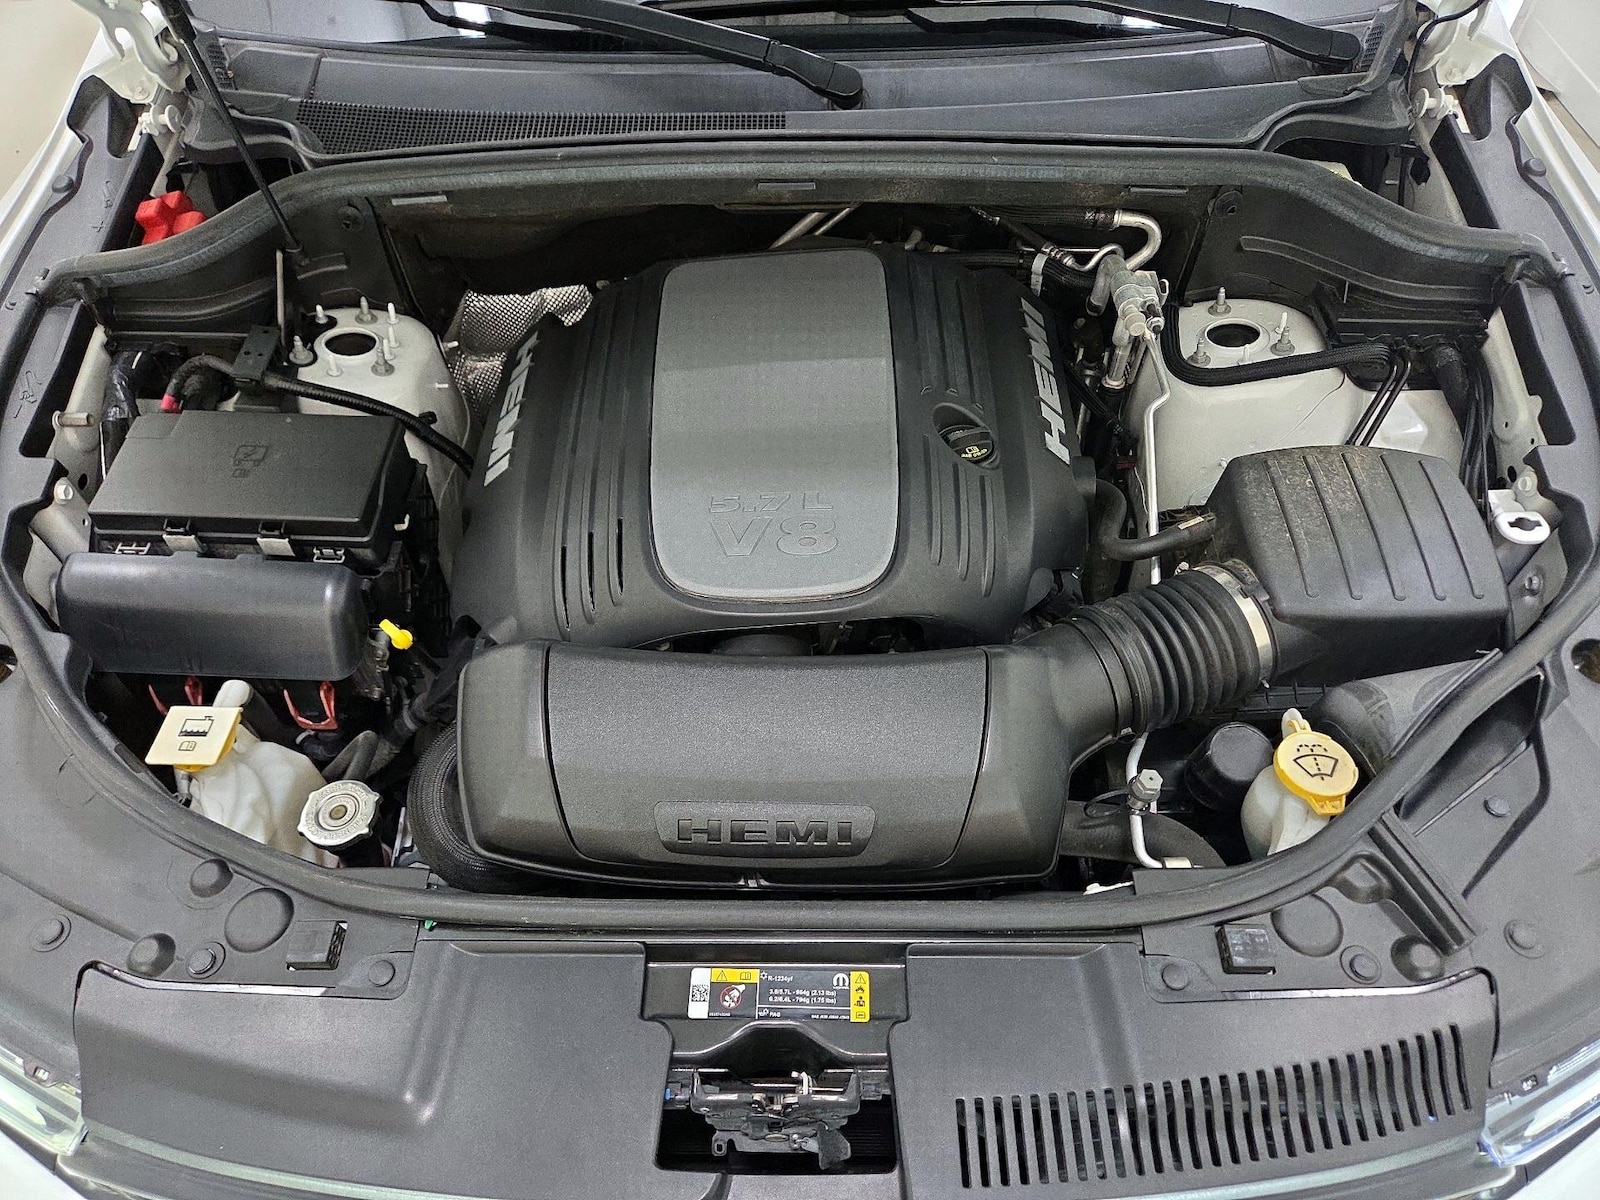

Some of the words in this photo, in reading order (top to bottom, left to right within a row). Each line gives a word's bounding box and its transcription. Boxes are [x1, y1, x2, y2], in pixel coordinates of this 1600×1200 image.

[483, 330, 539, 487] HEMI
[1020, 297, 1071, 465] HEMI
[708, 516, 839, 557] V8
[677, 818, 853, 846] HEMI
